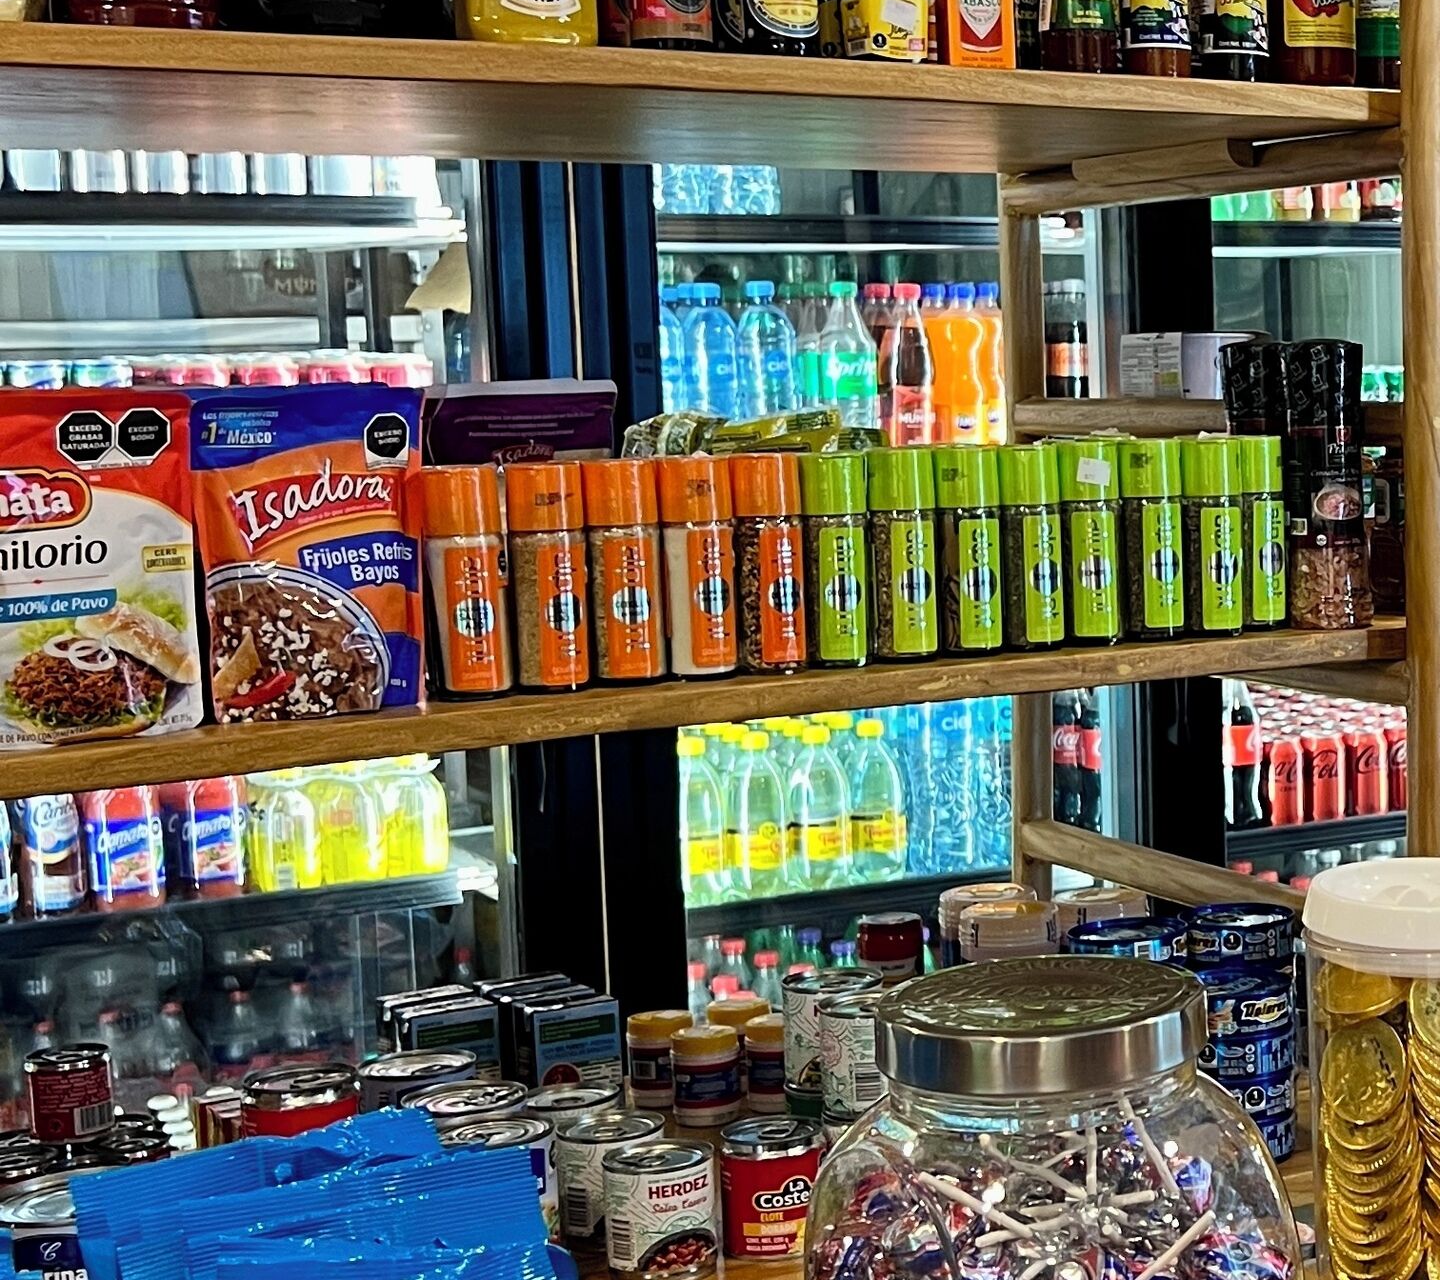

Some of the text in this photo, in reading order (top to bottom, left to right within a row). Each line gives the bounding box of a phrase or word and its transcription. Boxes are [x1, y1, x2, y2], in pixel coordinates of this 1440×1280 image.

[69, 424, 102, 432] EXCESO
[128, 425, 159, 433] EXCESO
[69, 433, 103, 441] GRASAS
[131, 434, 155, 442] SODIO
[226, 428, 273, 445] México
[62, 441, 110, 451] SATURADAS
[236, 457, 392, 541] Isadora
[303, 547, 370, 569] Frijoles
[350, 564, 399, 584] Bayos
[8, 595, 108, 616] 100% de Pavo
[648, 1174, 709, 1200] HERDEZ
[789, 1180, 804, 1192] La
